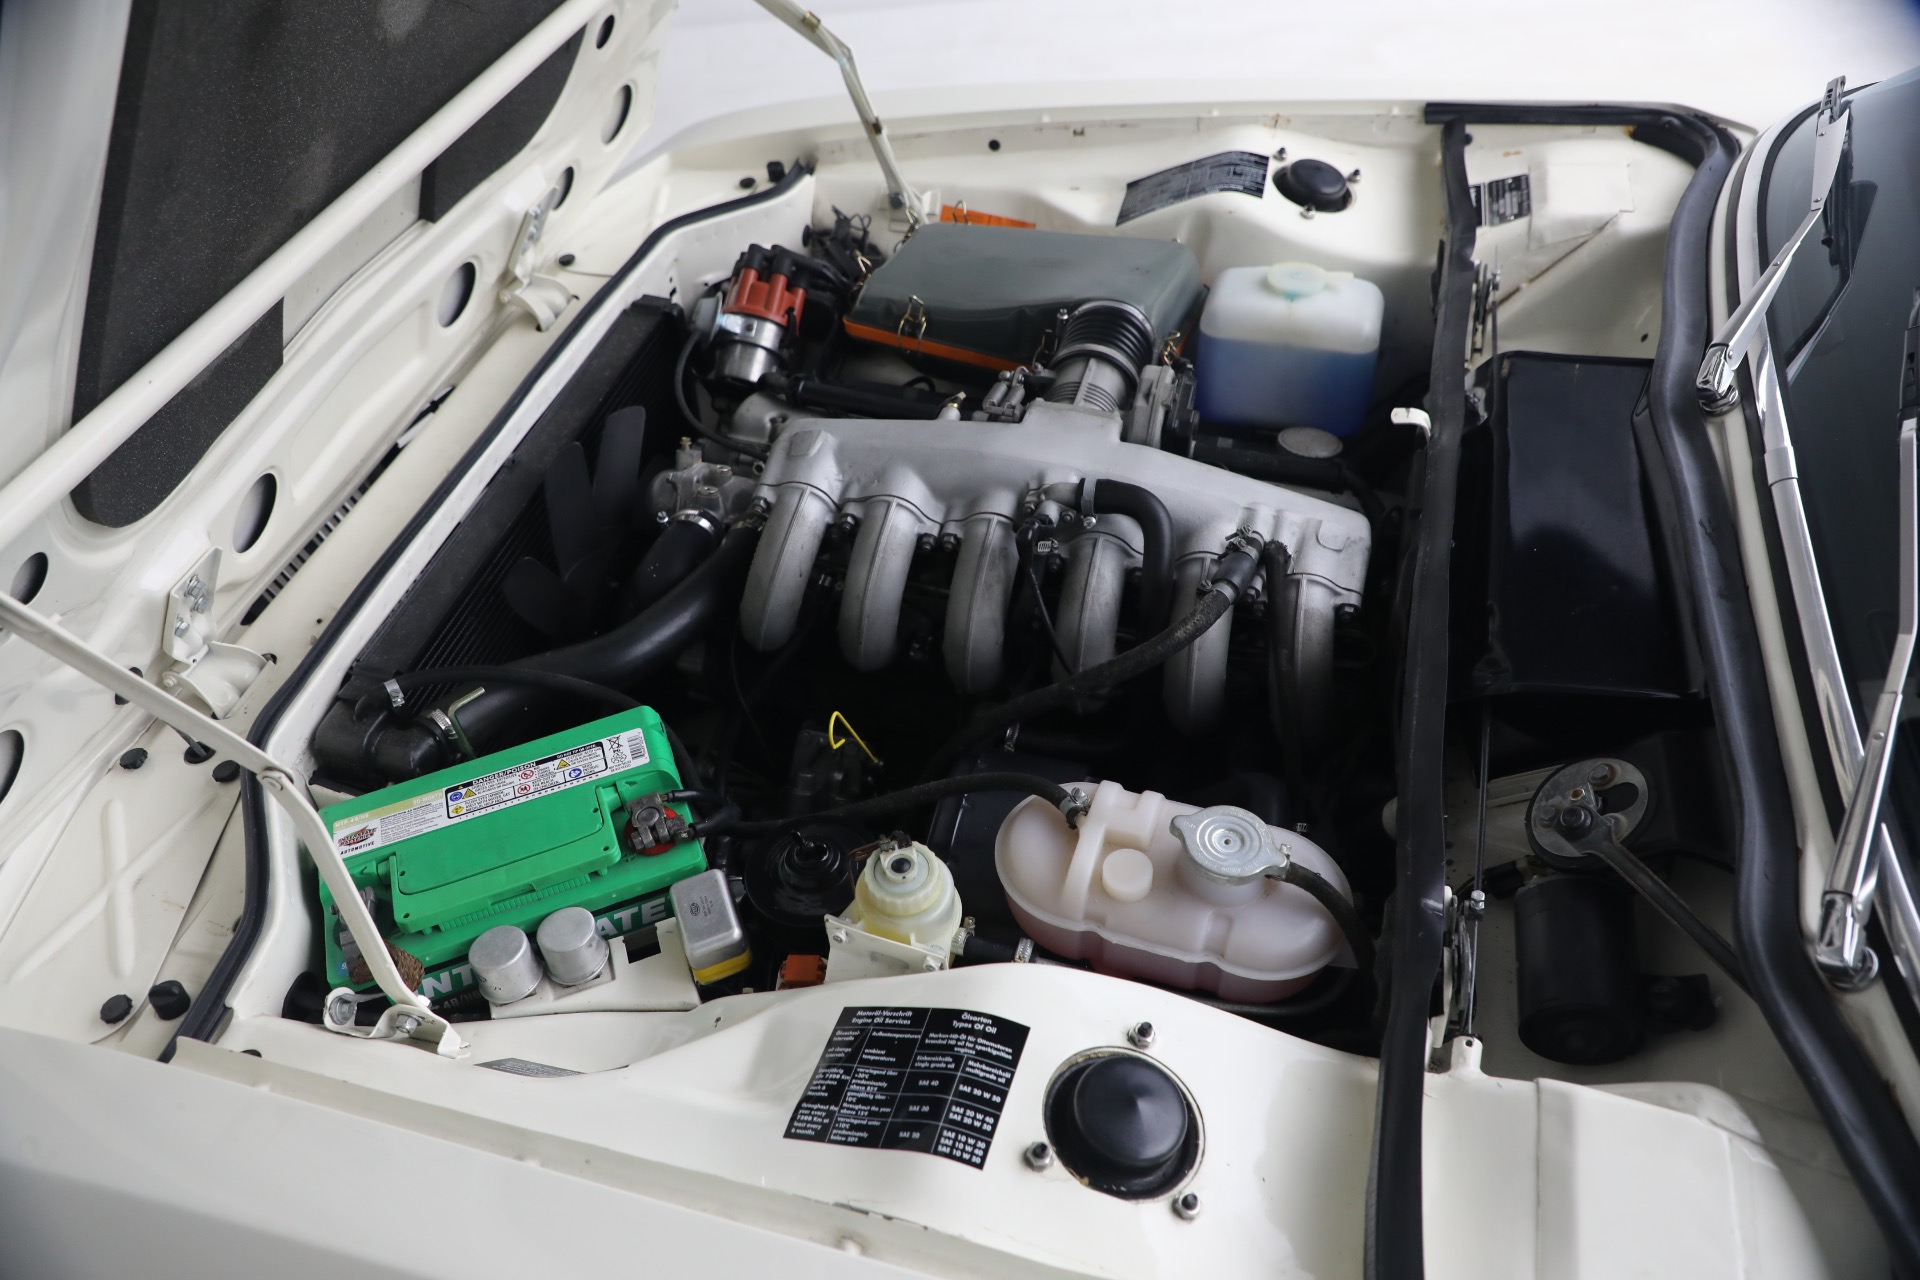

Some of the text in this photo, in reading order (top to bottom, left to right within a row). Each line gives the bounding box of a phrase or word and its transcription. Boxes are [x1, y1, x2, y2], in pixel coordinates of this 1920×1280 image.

[472, 762, 536, 785] DANGER/POISON
[340, 841, 374, 855] AUTOMOTIVE
[953, 1021, 972, 1029] Types
[986, 1025, 997, 1034] Oil
[962, 1012, 992, 1024] Ölsorten
[862, 1054, 896, 1062] temperatures
[959, 1084, 1001, 1103] SAE 20 W 50
[949, 1113, 961, 1122] SAE
[963, 1116, 972, 1125] 20
[982, 1123, 992, 1132] 50
[951, 1105, 994, 1124] SAE 20 W 40
[940, 1137, 984, 1157] SAE 10 W 40
[943, 1130, 986, 1149] SAE 10 W 30
[938, 1145, 981, 1164] SAE 10 W 50
